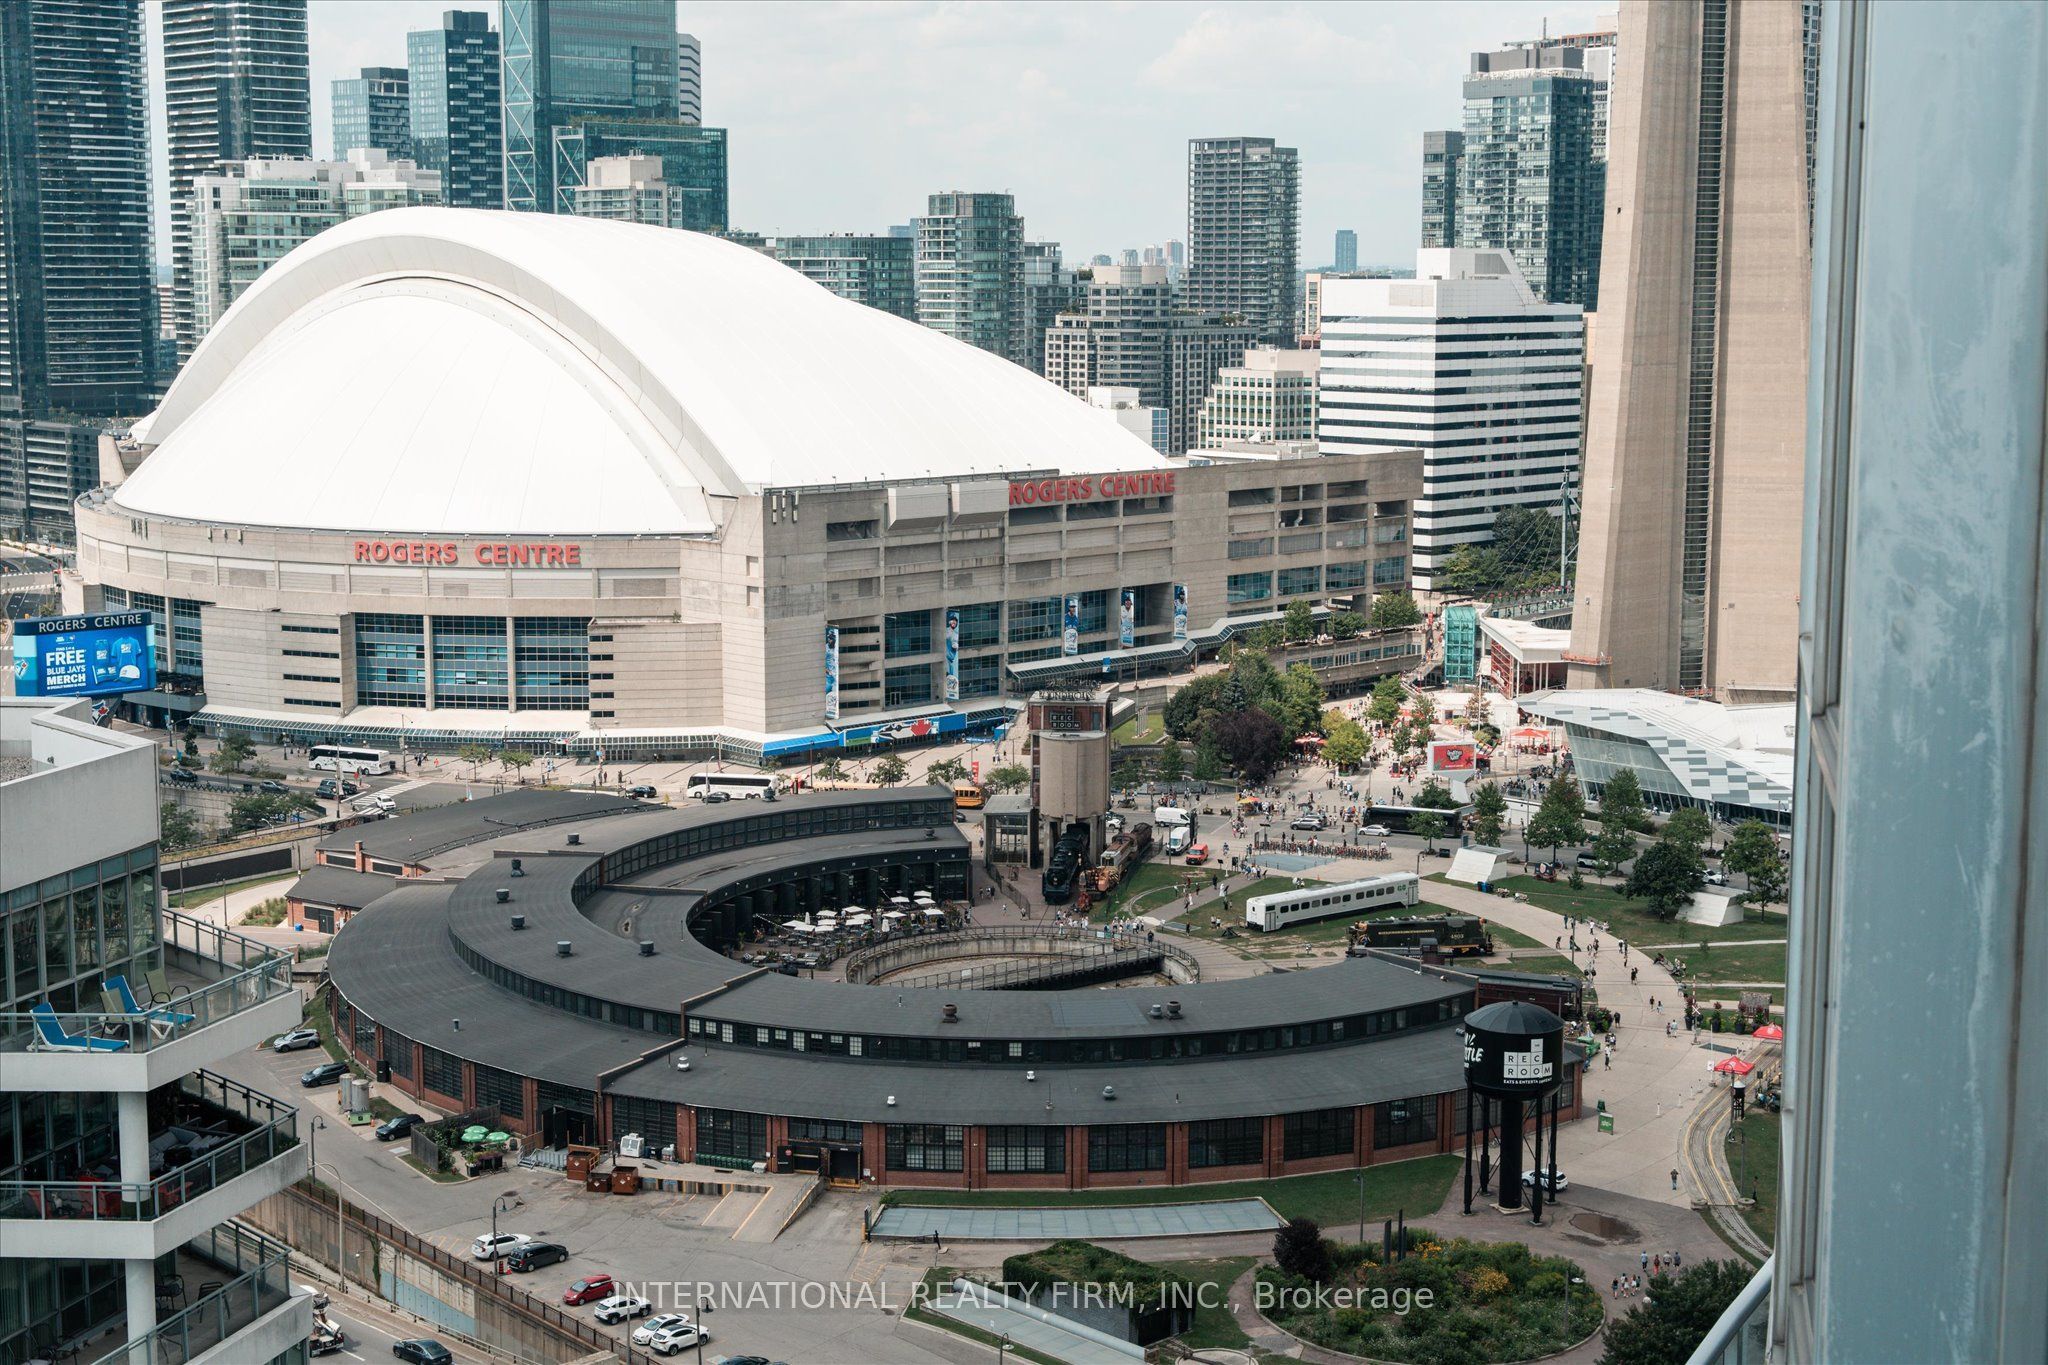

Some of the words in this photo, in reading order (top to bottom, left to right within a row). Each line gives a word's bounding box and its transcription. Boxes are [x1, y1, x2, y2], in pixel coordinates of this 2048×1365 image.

[1009, 477, 1092, 505] ROGERS
[1100, 472, 1176, 497] CENTRE
[354, 541, 458, 563] ROGERS
[474, 543, 581, 565] CENTRE
[38, 618, 87, 633] ROGERS
[94, 613, 142, 628] CENTRE
[46, 649, 86, 667] FREE
[46, 666, 66, 676] BLUE
[67, 664, 86, 673] JAYS
[47, 673, 86, 685] MERCH
[1508, 1055, 1540, 1063] REC
[1507, 1067, 1551, 1076] ROOM
